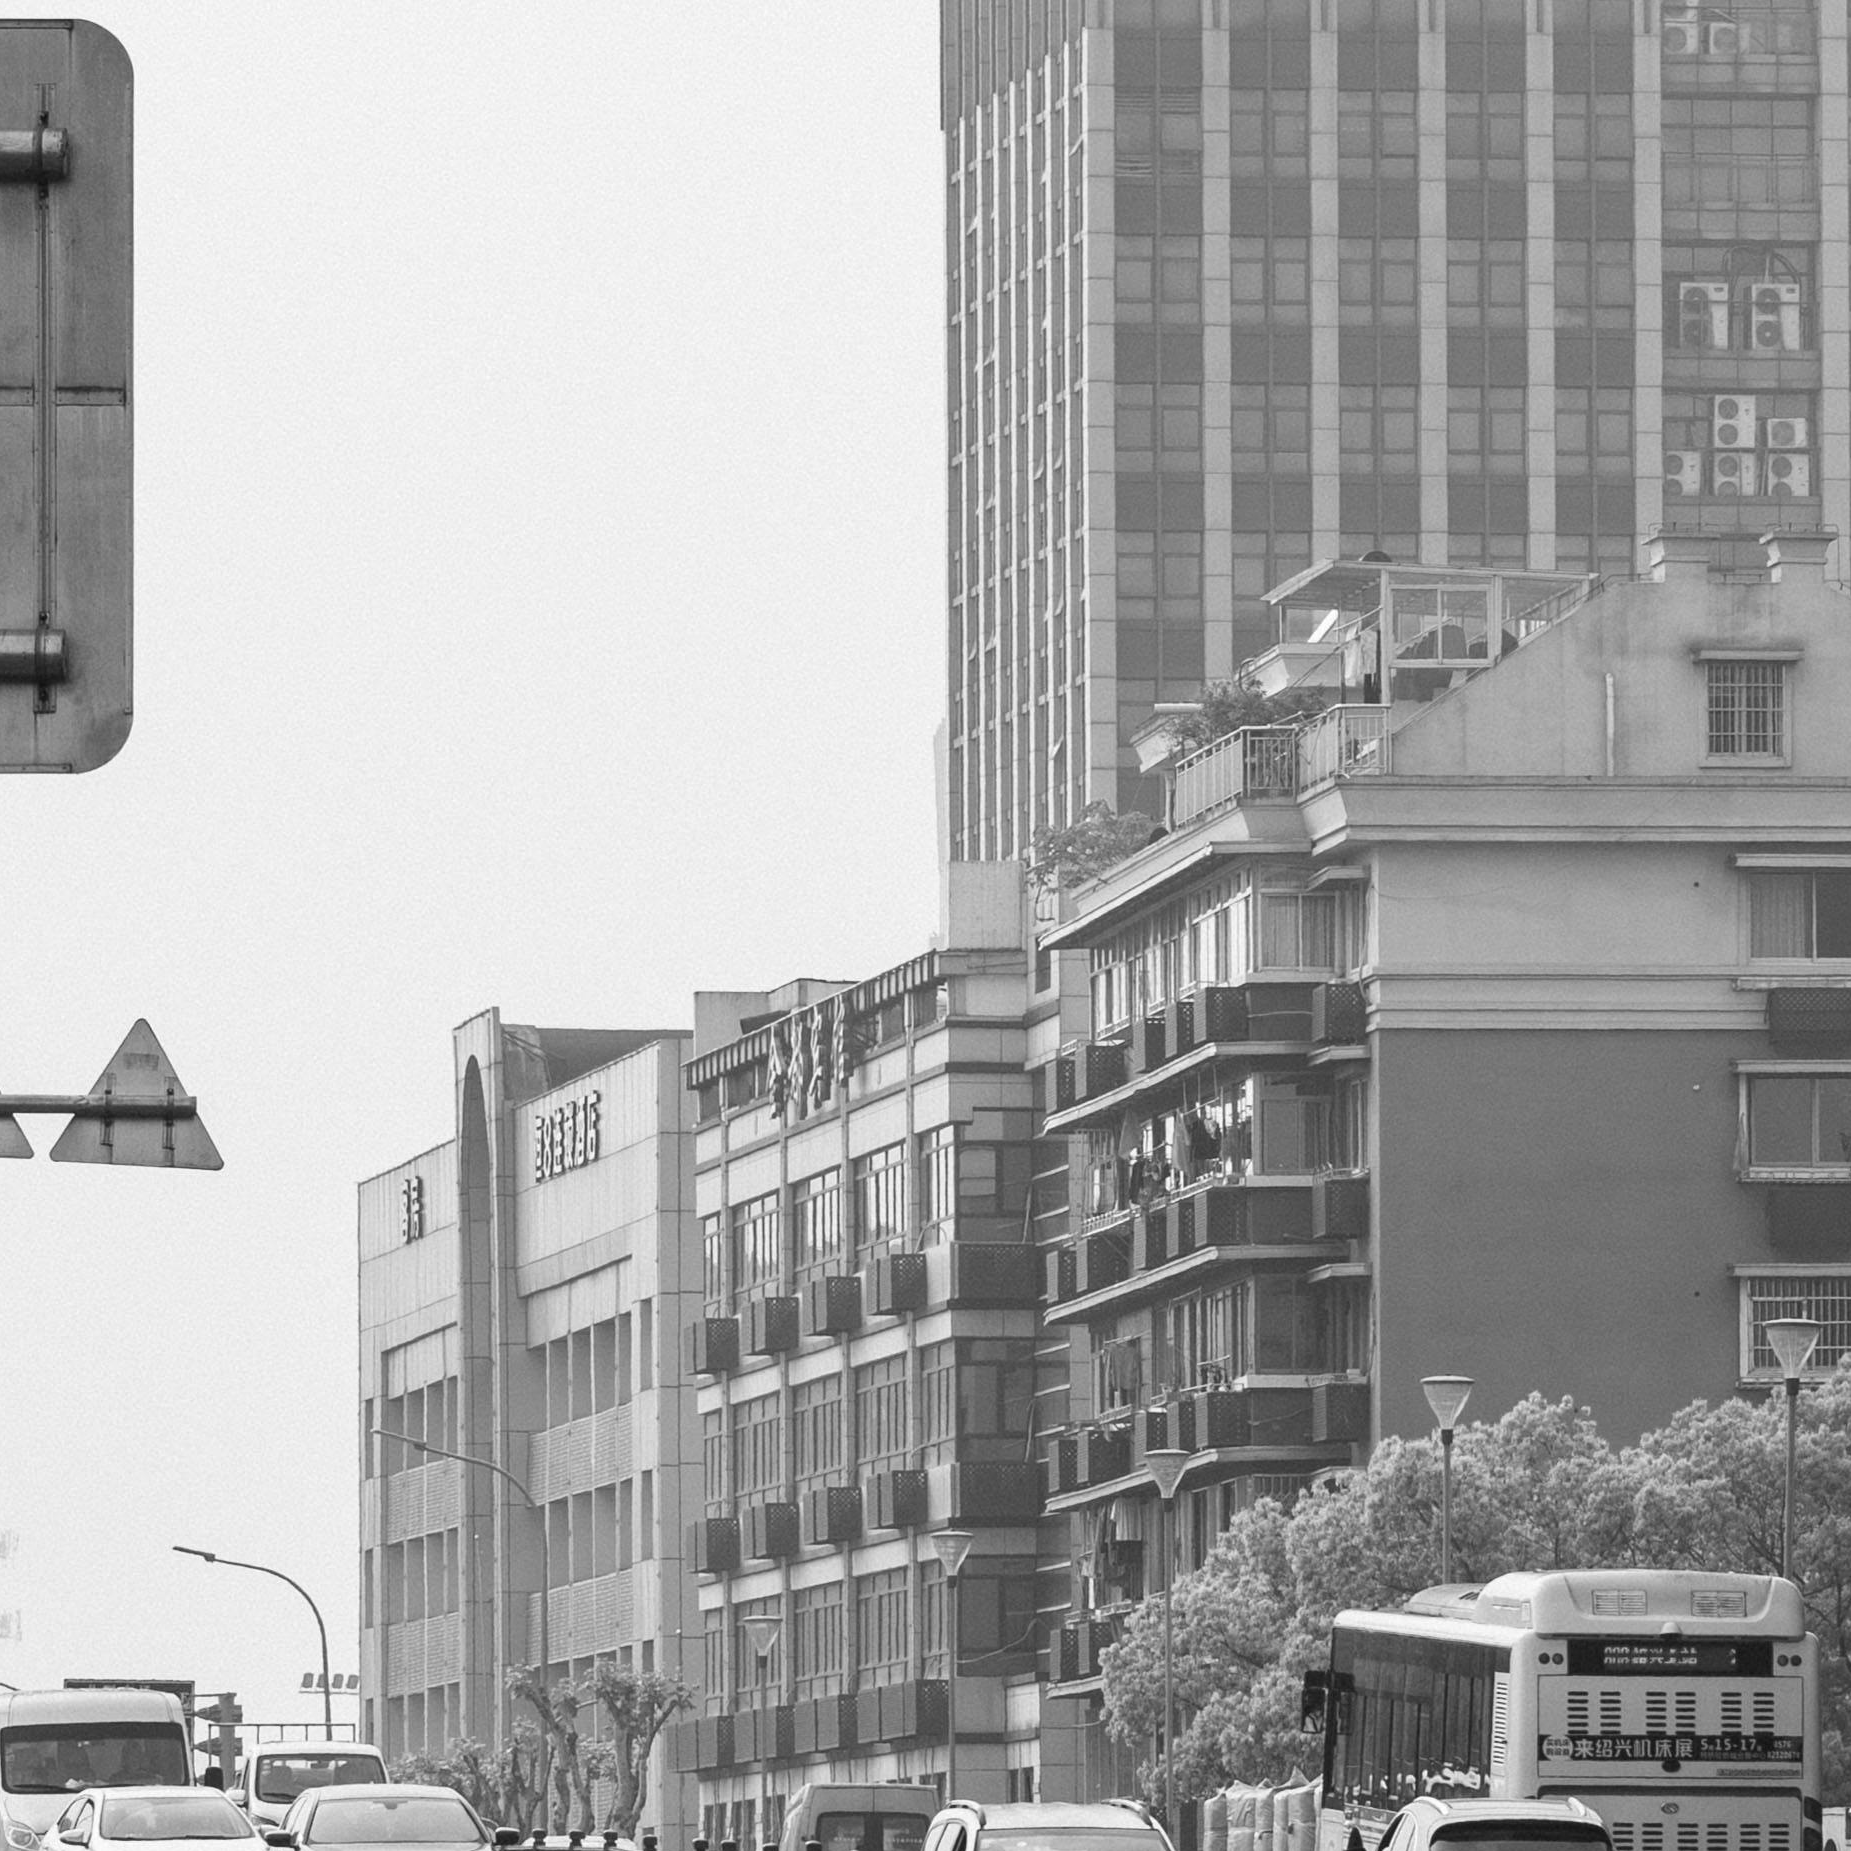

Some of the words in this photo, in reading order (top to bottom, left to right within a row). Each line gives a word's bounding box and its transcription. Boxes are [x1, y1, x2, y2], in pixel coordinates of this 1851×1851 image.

[1574, 1738, 1693, 1758] 来绍兴机床展
